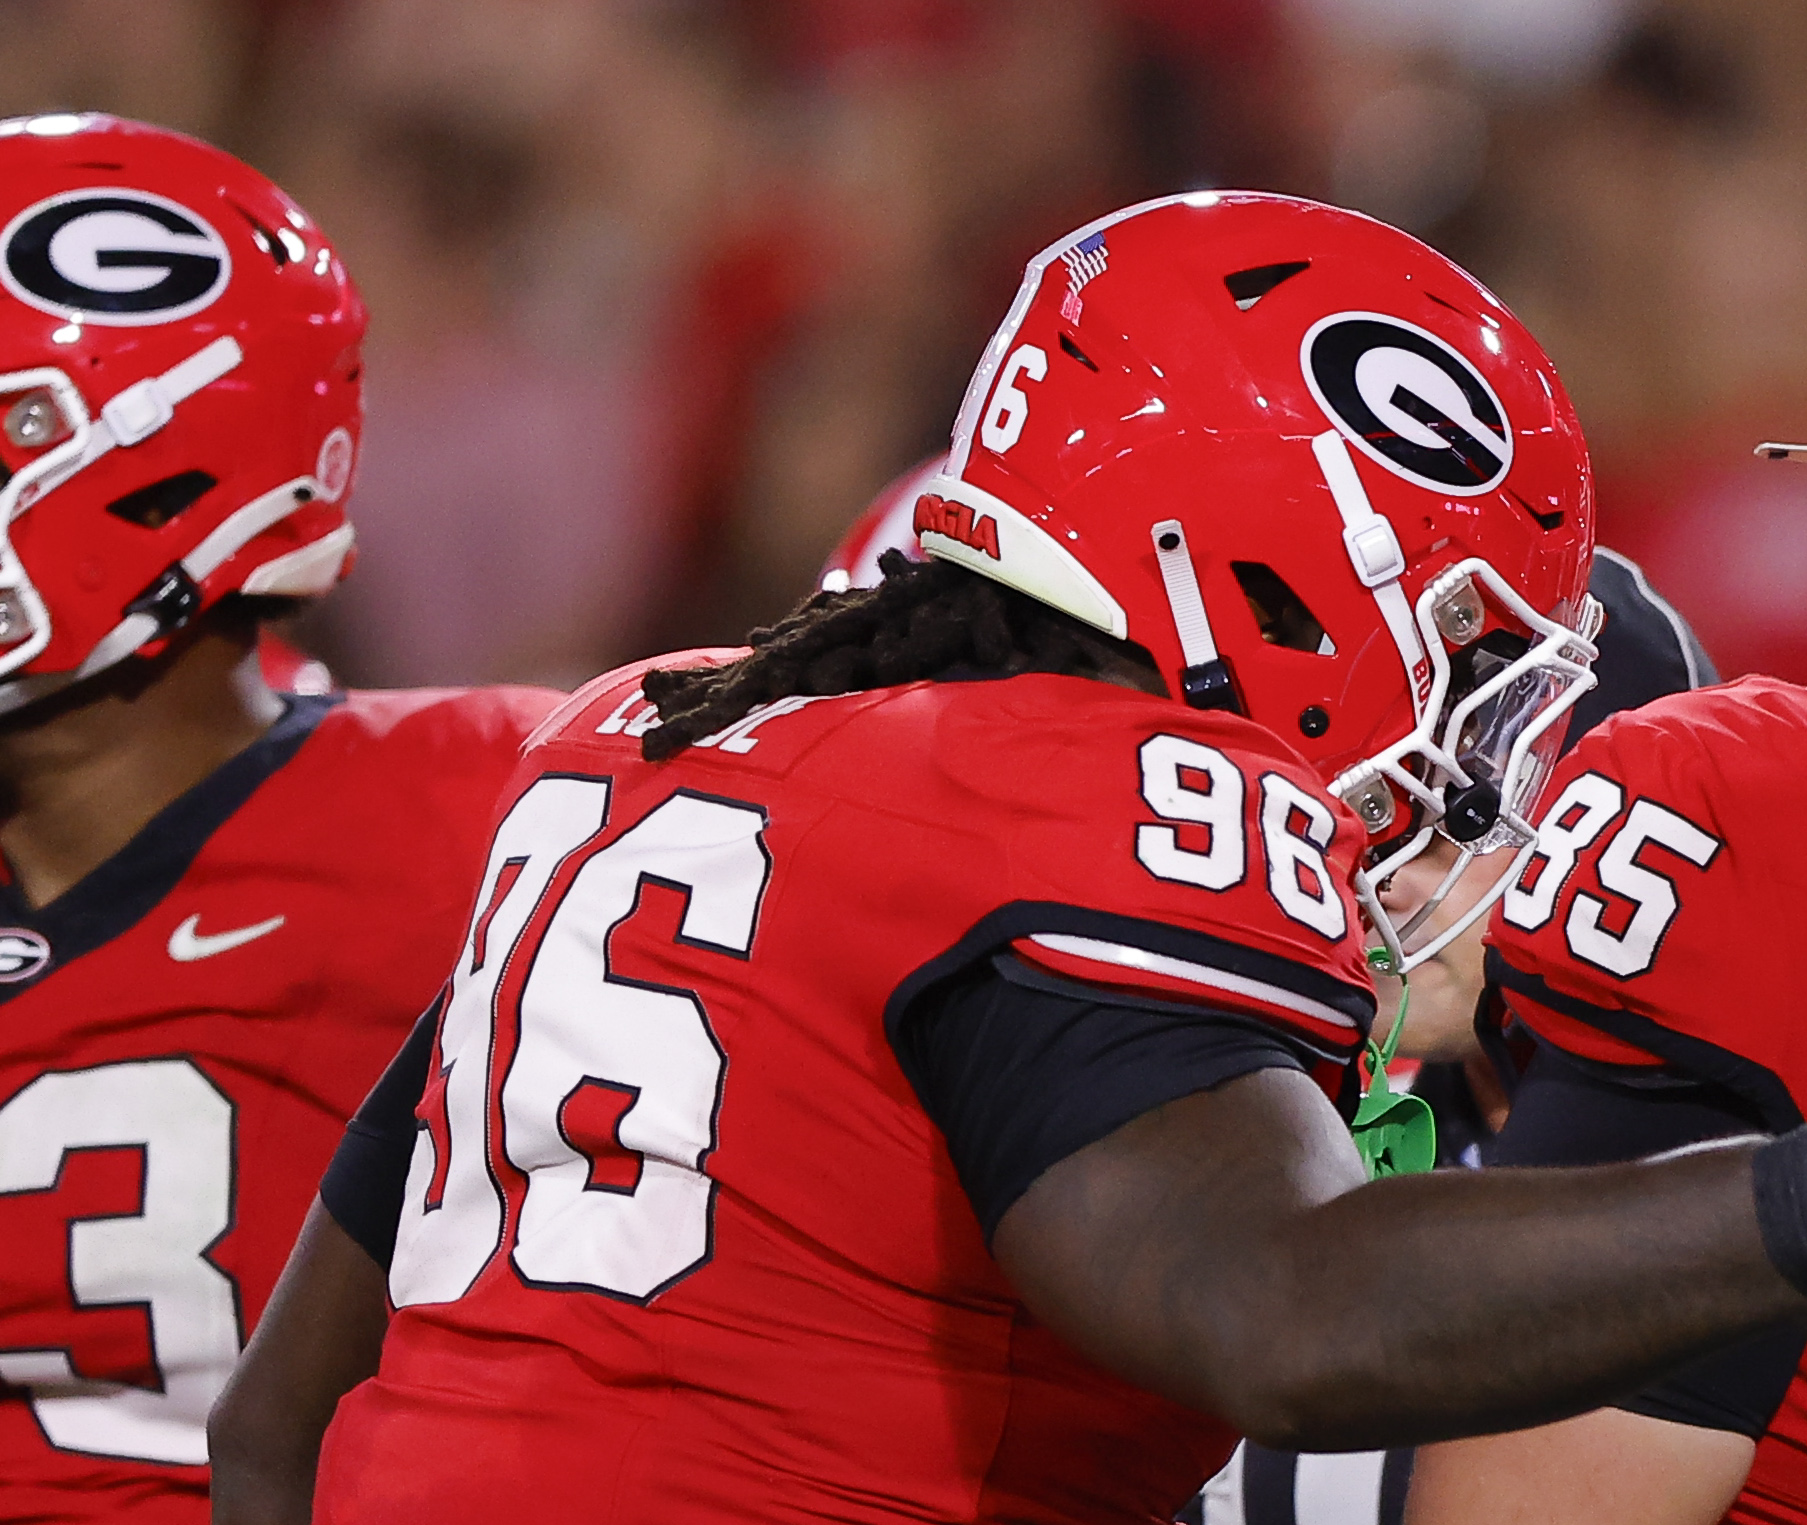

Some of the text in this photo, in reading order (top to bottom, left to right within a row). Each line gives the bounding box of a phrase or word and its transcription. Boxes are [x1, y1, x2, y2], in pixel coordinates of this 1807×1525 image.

[3, 196, 222, 313] G
[981, 344, 1049, 455] 6
[1308, 319, 1510, 490] G
[1136, 732, 1351, 942] 96
[1502, 770, 1723, 979] 85
[388, 772, 775, 1310] 96
